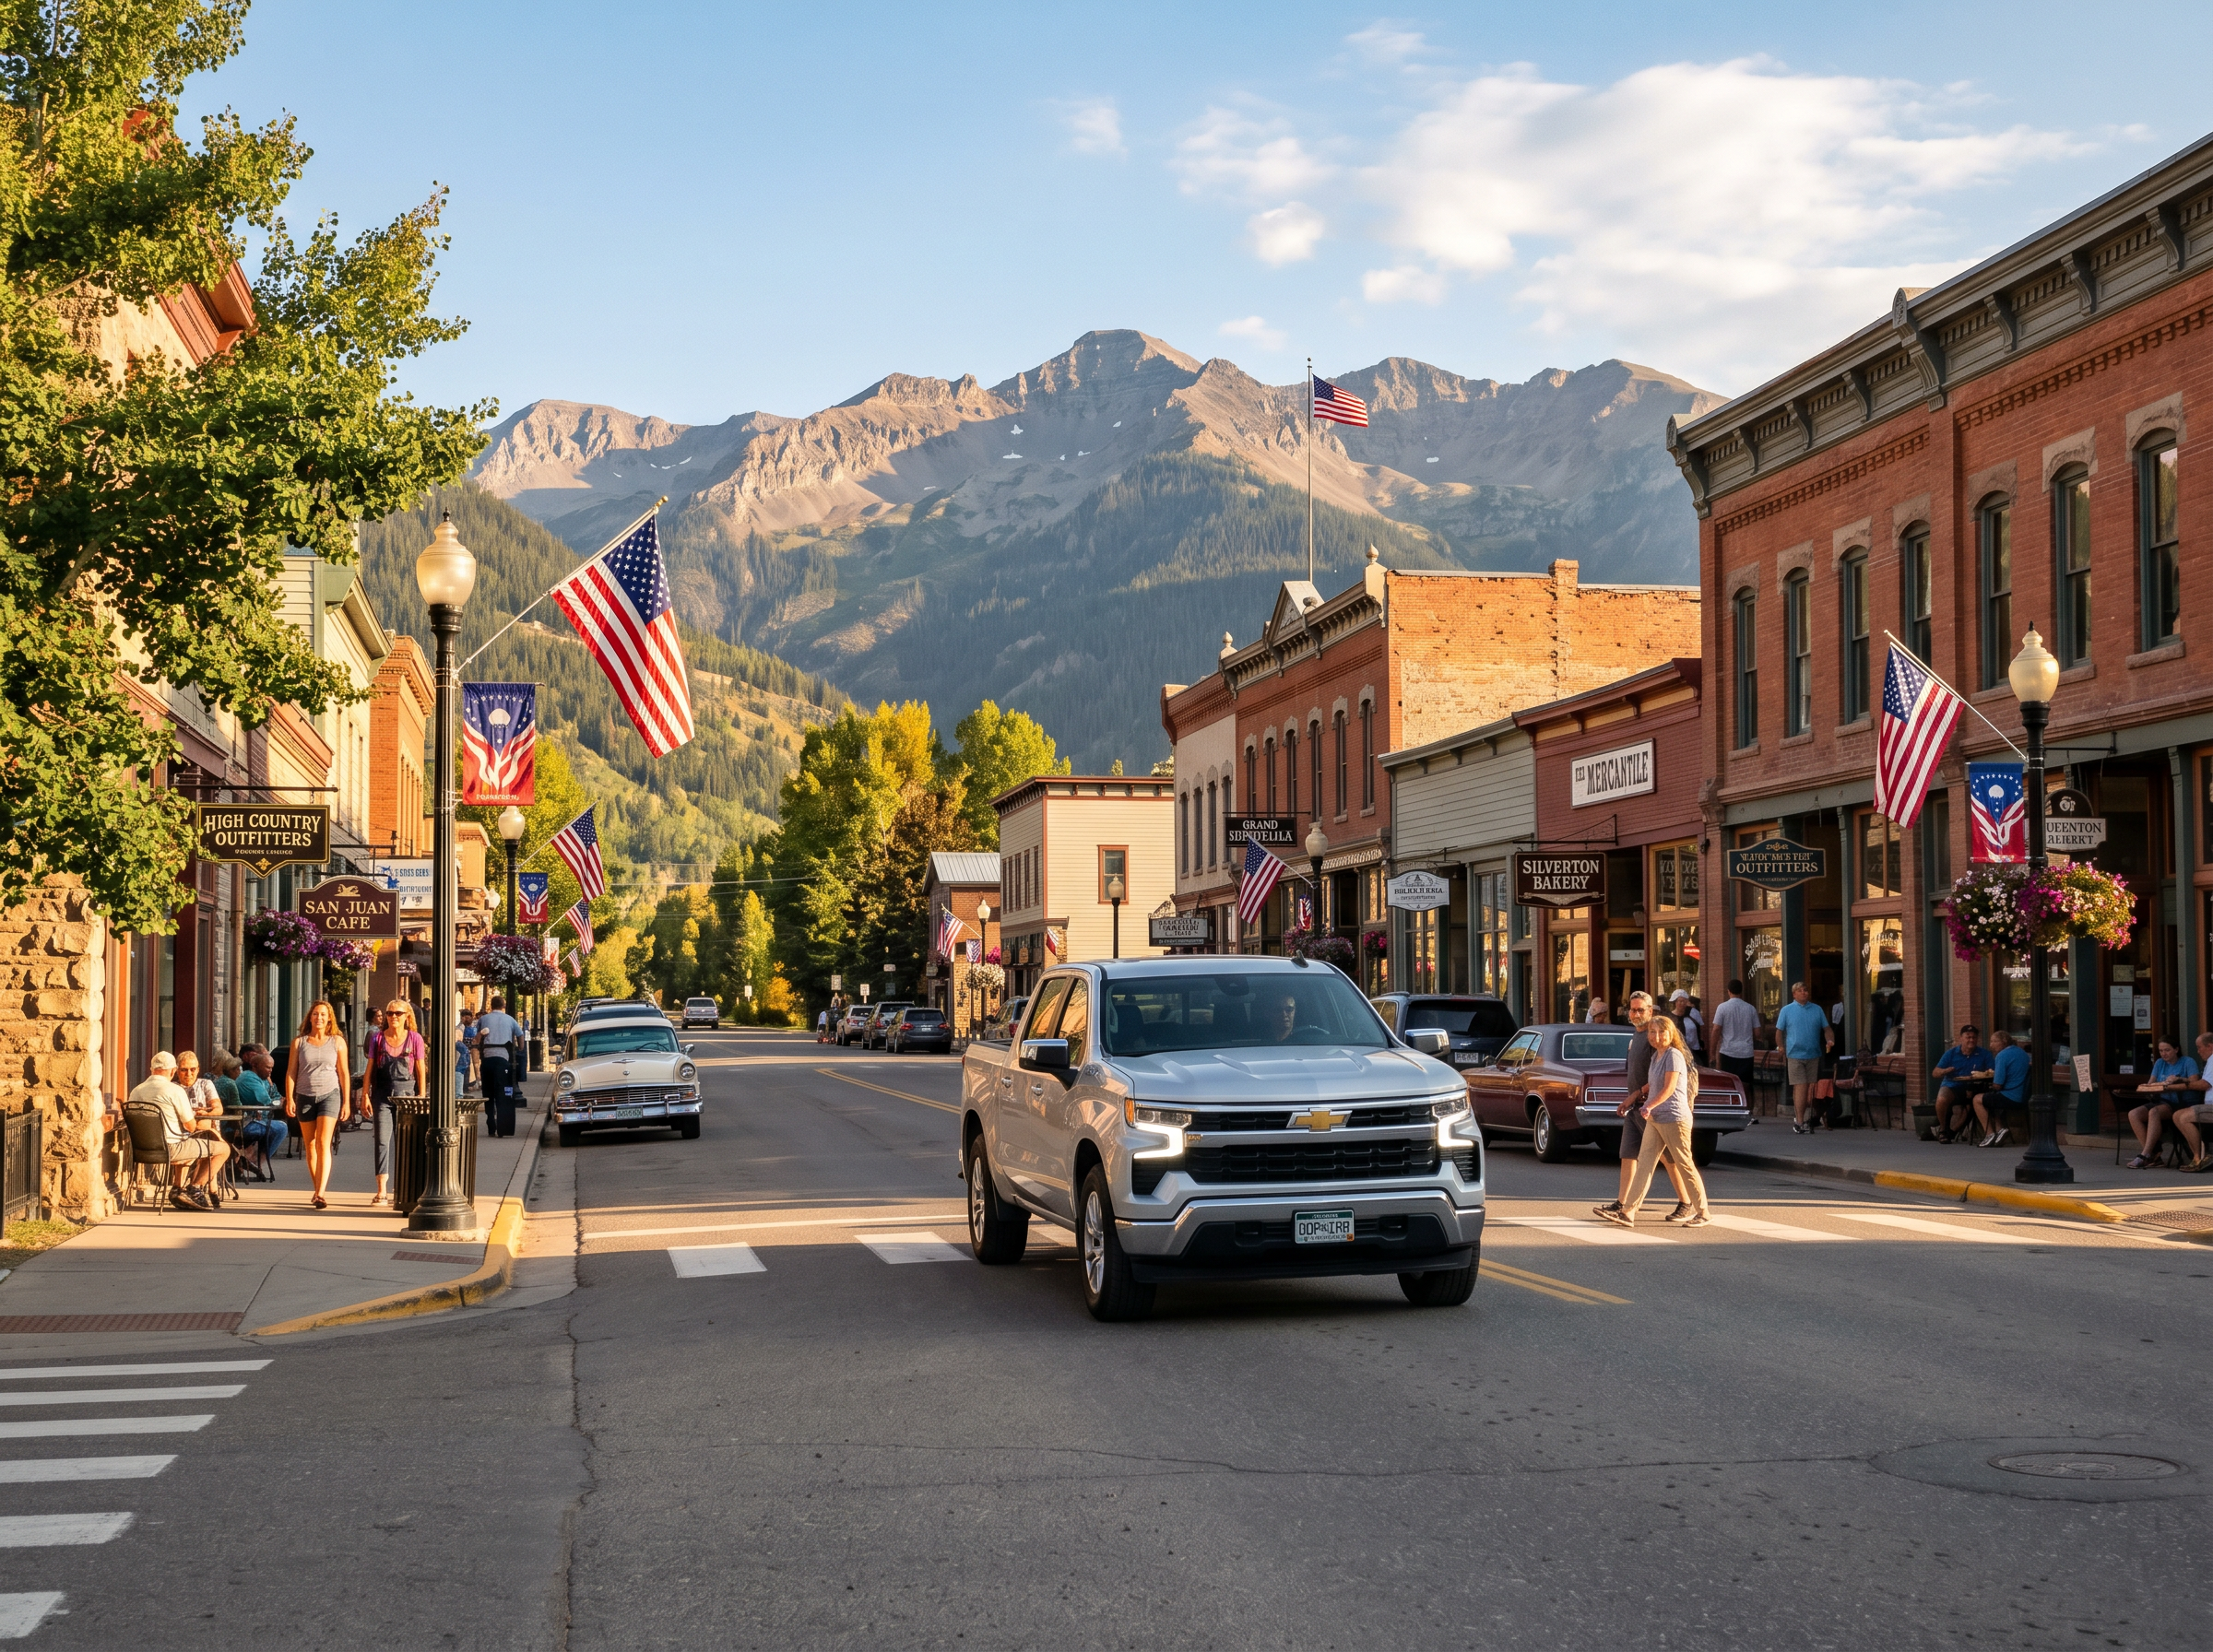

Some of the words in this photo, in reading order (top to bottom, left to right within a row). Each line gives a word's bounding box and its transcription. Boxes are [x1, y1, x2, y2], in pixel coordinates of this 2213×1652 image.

[1587, 750, 1649, 795] MERCANTILE
[204, 813, 244, 834] HIGH
[248, 813, 321, 833] COUNTRY
[1242, 820, 1279, 830] GRAND
[215, 831, 312, 847] OUTFITTERS
[1522, 859, 1600, 874] SILVERTON
[1735, 861, 1818, 874] OUTFITTERS
[1533, 875, 1591, 891] BAKERY
[305, 900, 340, 914] SAN
[345, 900, 392, 914] JUAN
[325, 915, 371, 930] CAFE
